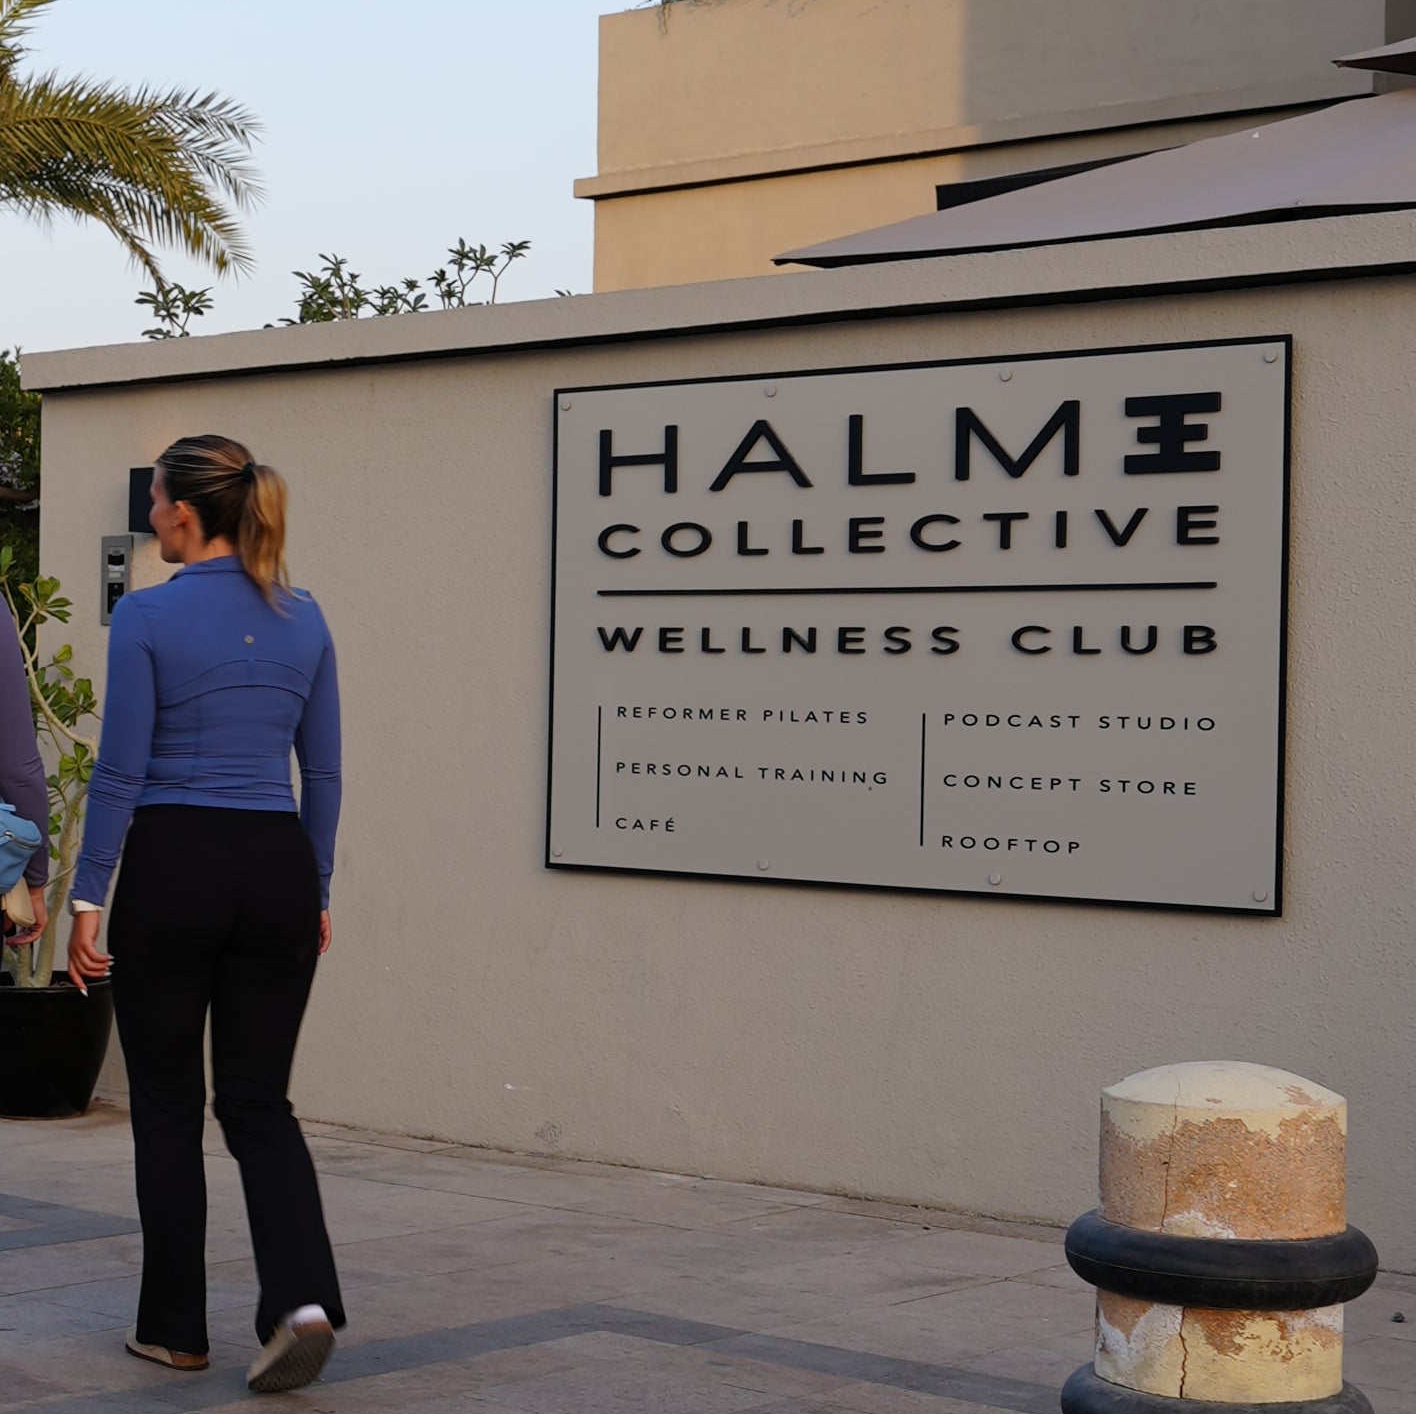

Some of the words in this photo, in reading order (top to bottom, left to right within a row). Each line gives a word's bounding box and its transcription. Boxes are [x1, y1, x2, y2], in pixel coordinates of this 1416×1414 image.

[597, 504, 1221, 560] COLLECTIVE
[596, 626, 961, 656] WELLNESS
[1010, 625, 1219, 656] CLUB
[615, 706, 749, 722] REFORMER
[762, 709, 869, 725] PILATES
[943, 713, 1082, 730] PODCAST
[1097, 715, 1217, 732] STUDIO
[615, 761, 745, 779] PERSONAL
[757, 767, 888, 785] TRAINING
[942, 774, 1082, 792] CONCEPT
[1098, 779, 1198, 796] STORE
[615, 817, 677, 833] CAFÉ
[941, 835, 1082, 854] ROOFTOP
